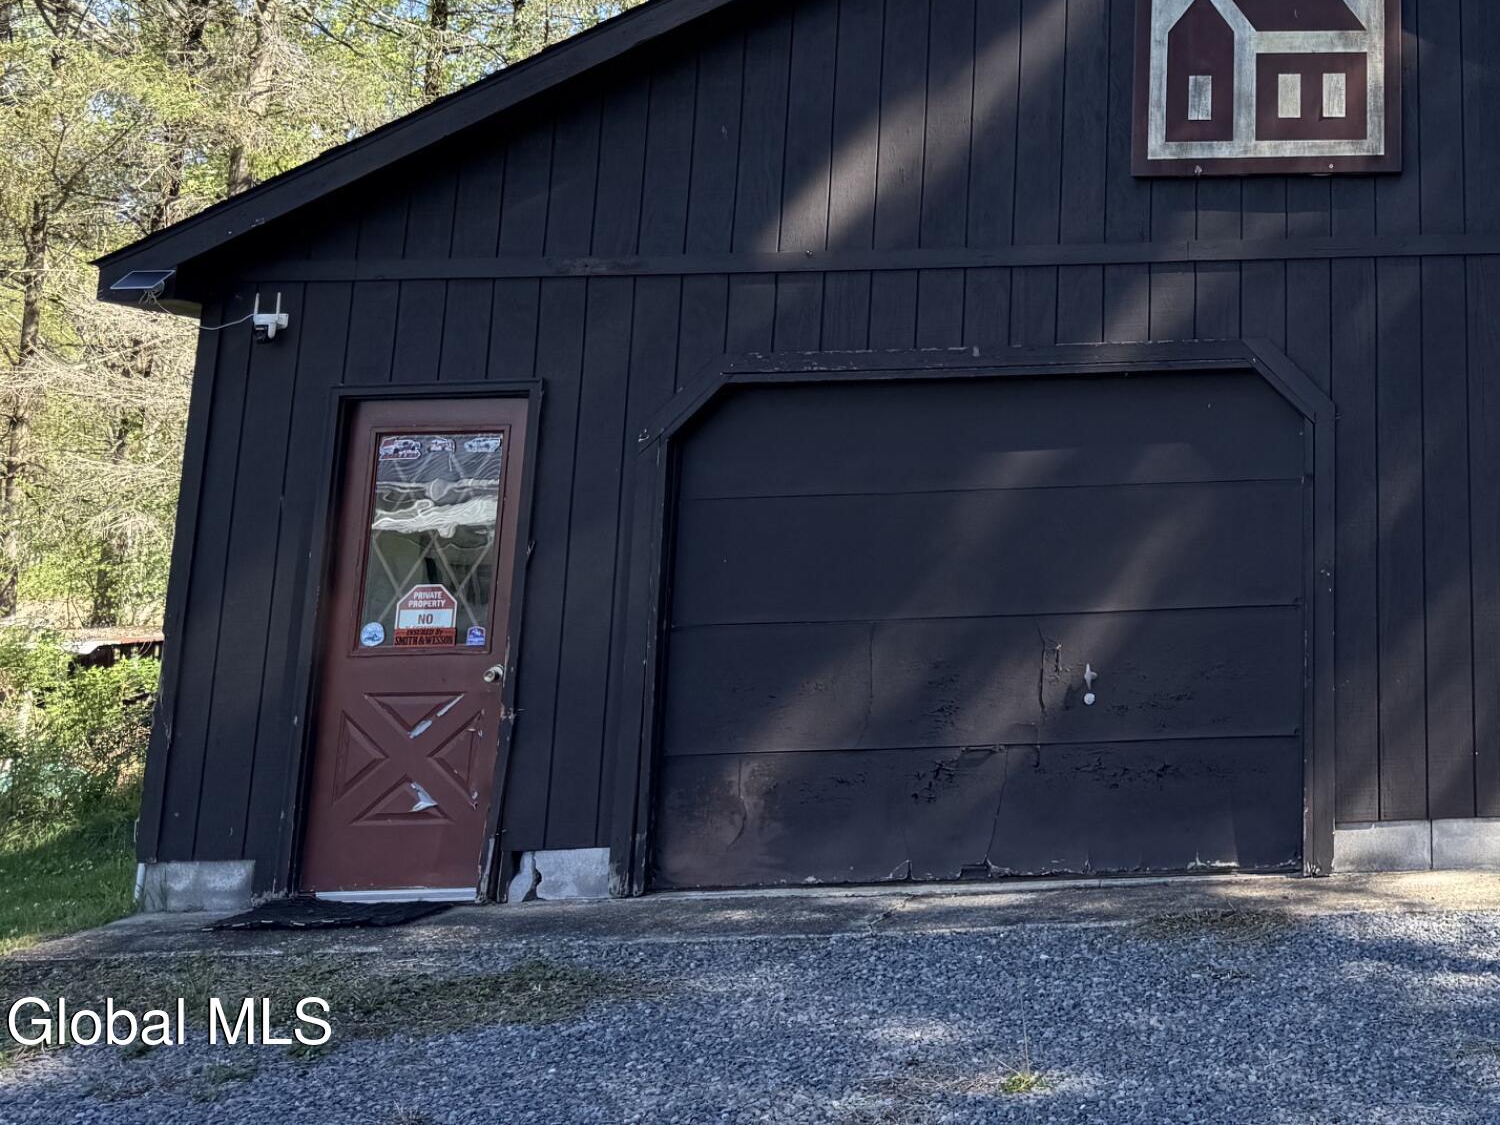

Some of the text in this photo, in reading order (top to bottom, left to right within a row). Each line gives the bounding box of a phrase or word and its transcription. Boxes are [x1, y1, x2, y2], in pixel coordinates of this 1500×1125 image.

[413, 591, 442, 599] PRIVATE
[408, 600, 446, 608] PROPERTY
[418, 613, 434, 625] NO
[395, 636, 418, 645] SMITH
[426, 636, 453, 645] WESSON
